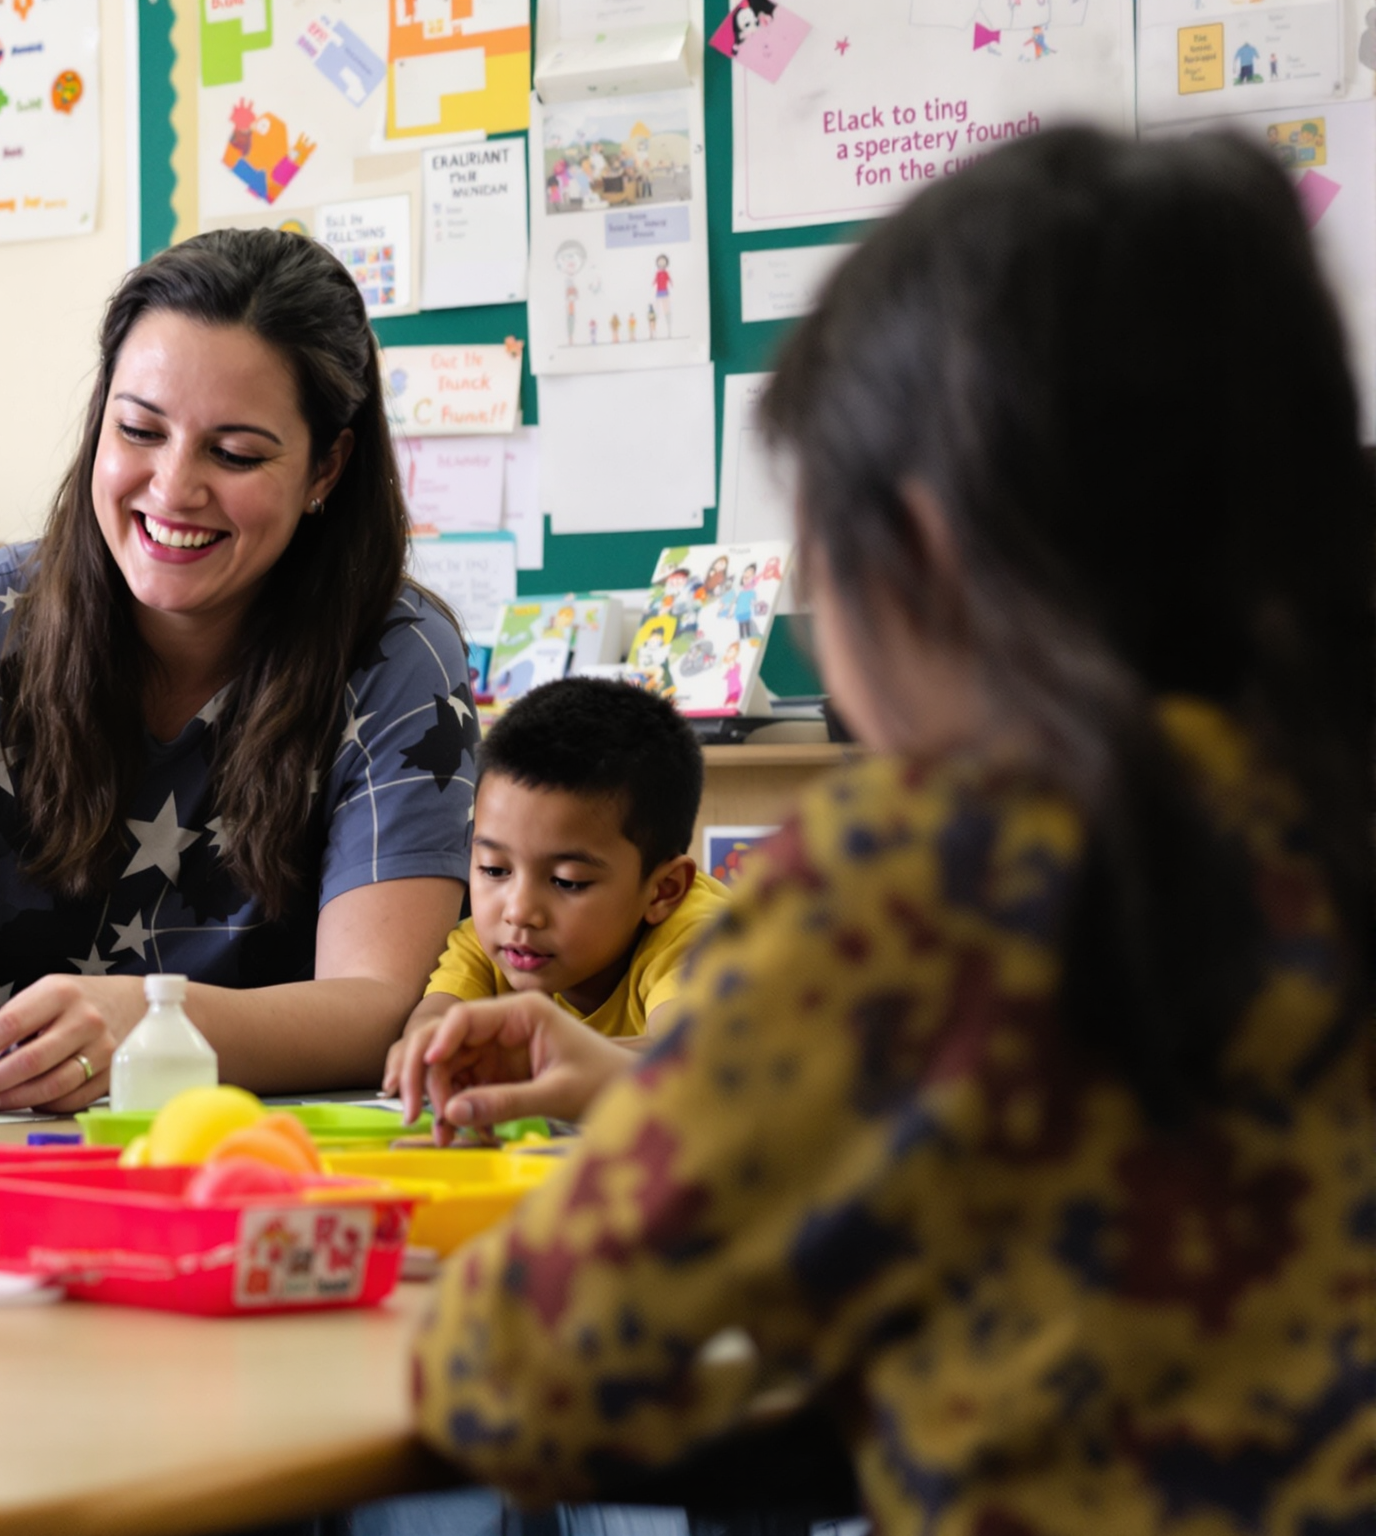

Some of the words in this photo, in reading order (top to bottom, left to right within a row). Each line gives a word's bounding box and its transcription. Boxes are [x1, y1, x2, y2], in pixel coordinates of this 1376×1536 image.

[892, 105, 916, 126] to
[925, 98, 967, 122] ting
[836, 142, 848, 160] a
[853, 129, 958, 162] speratery
[966, 111, 1040, 143] founch
[855, 163, 891, 187] fon
[898, 157, 935, 182] the
